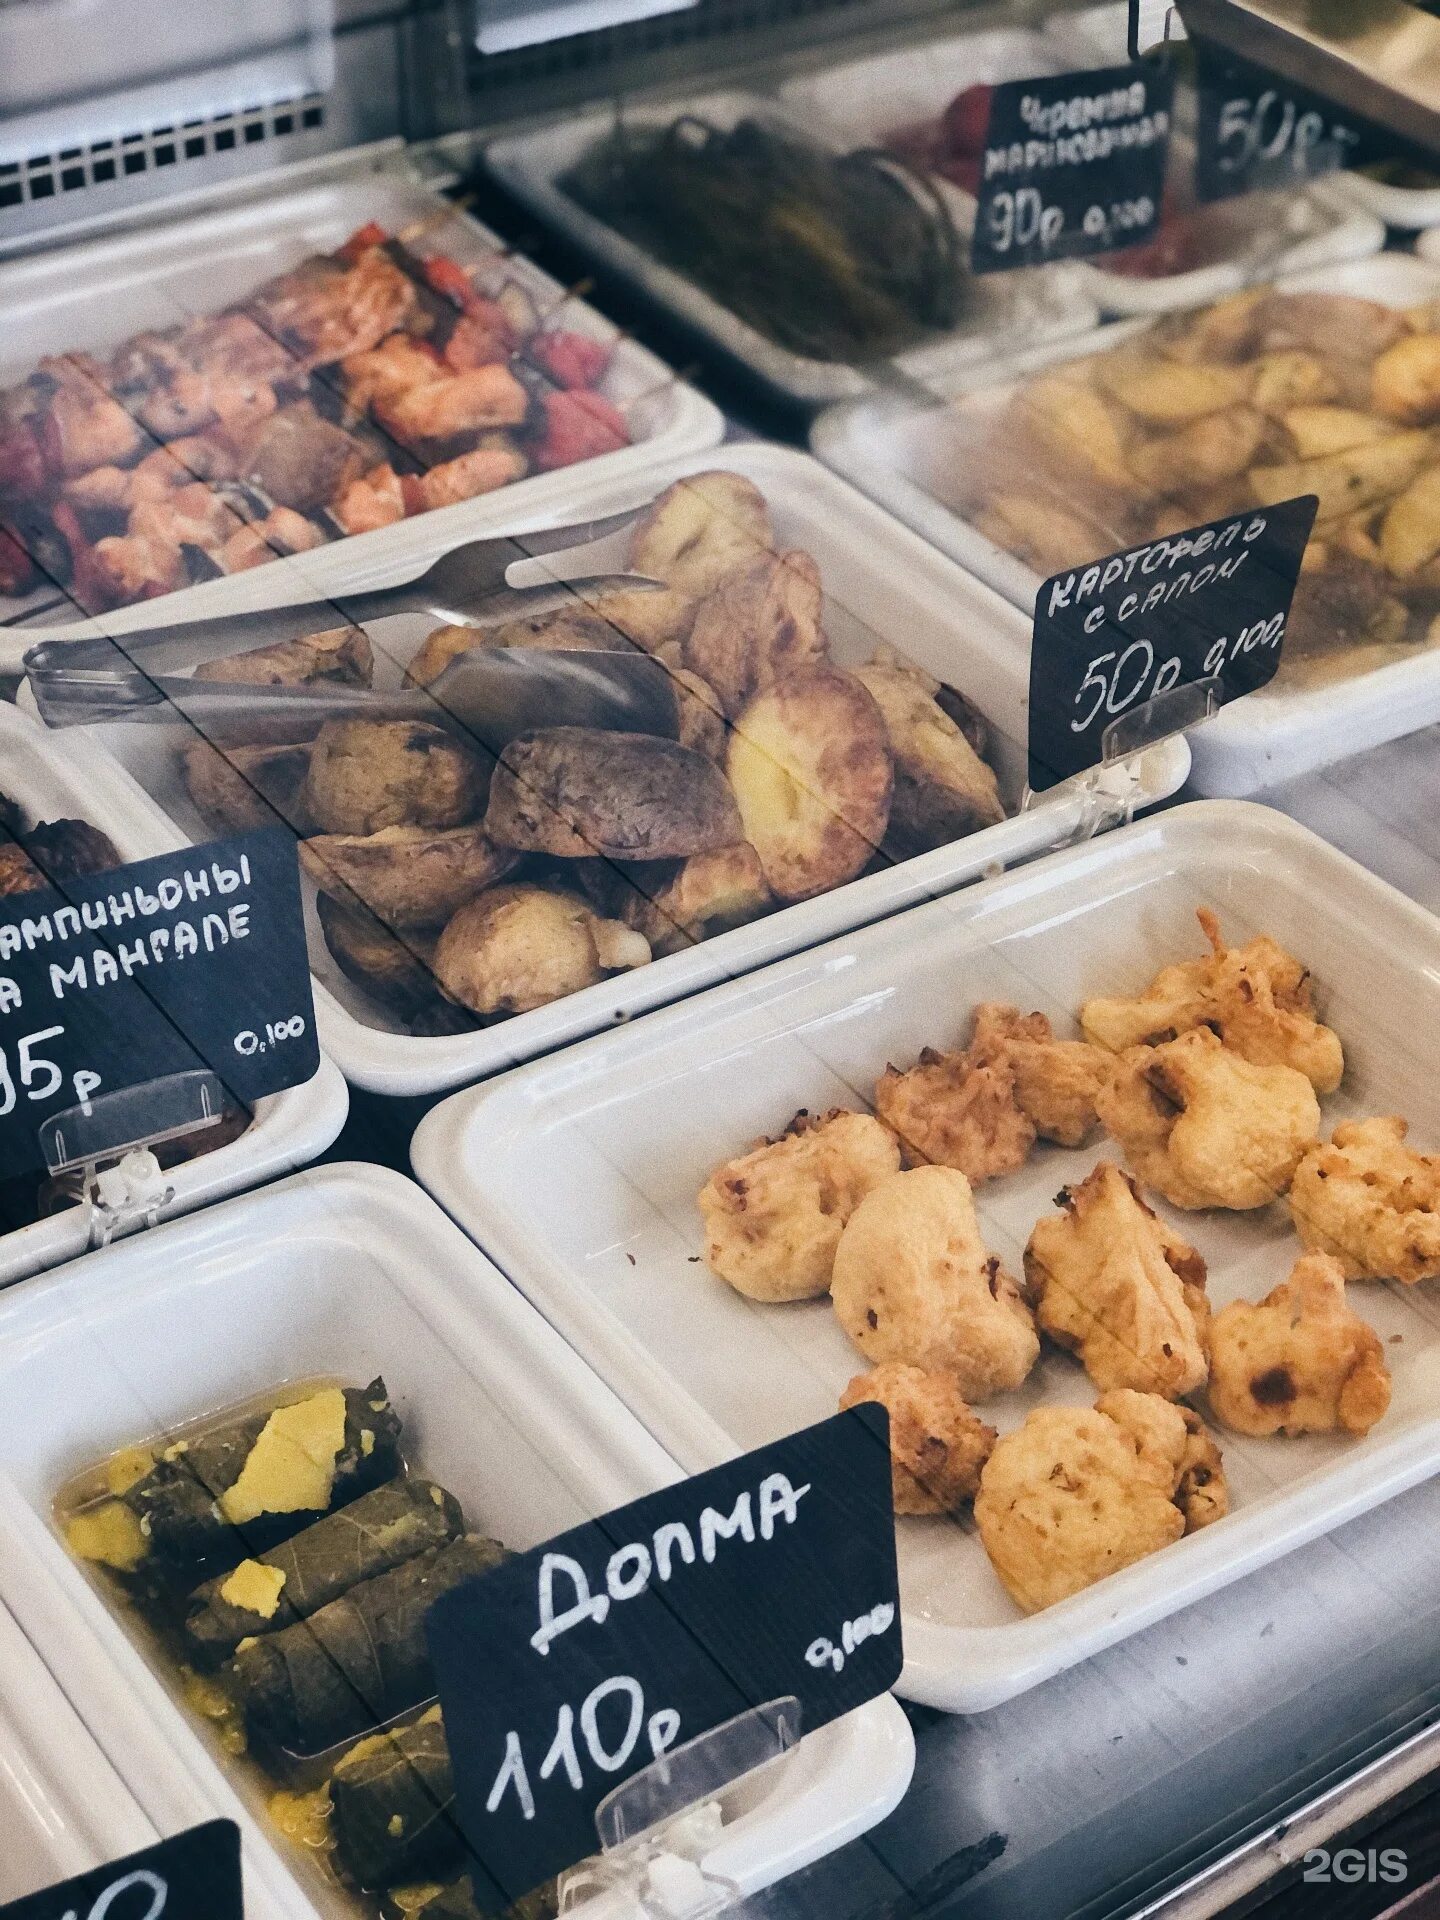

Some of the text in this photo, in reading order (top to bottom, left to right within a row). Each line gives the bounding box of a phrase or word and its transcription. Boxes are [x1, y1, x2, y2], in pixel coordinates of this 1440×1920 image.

[49, 903, 251, 999] МАНГАЛЕ
[233, 1015, 306, 1056] 0,100
[530, 1472, 812, 1656] ДОЛМА
